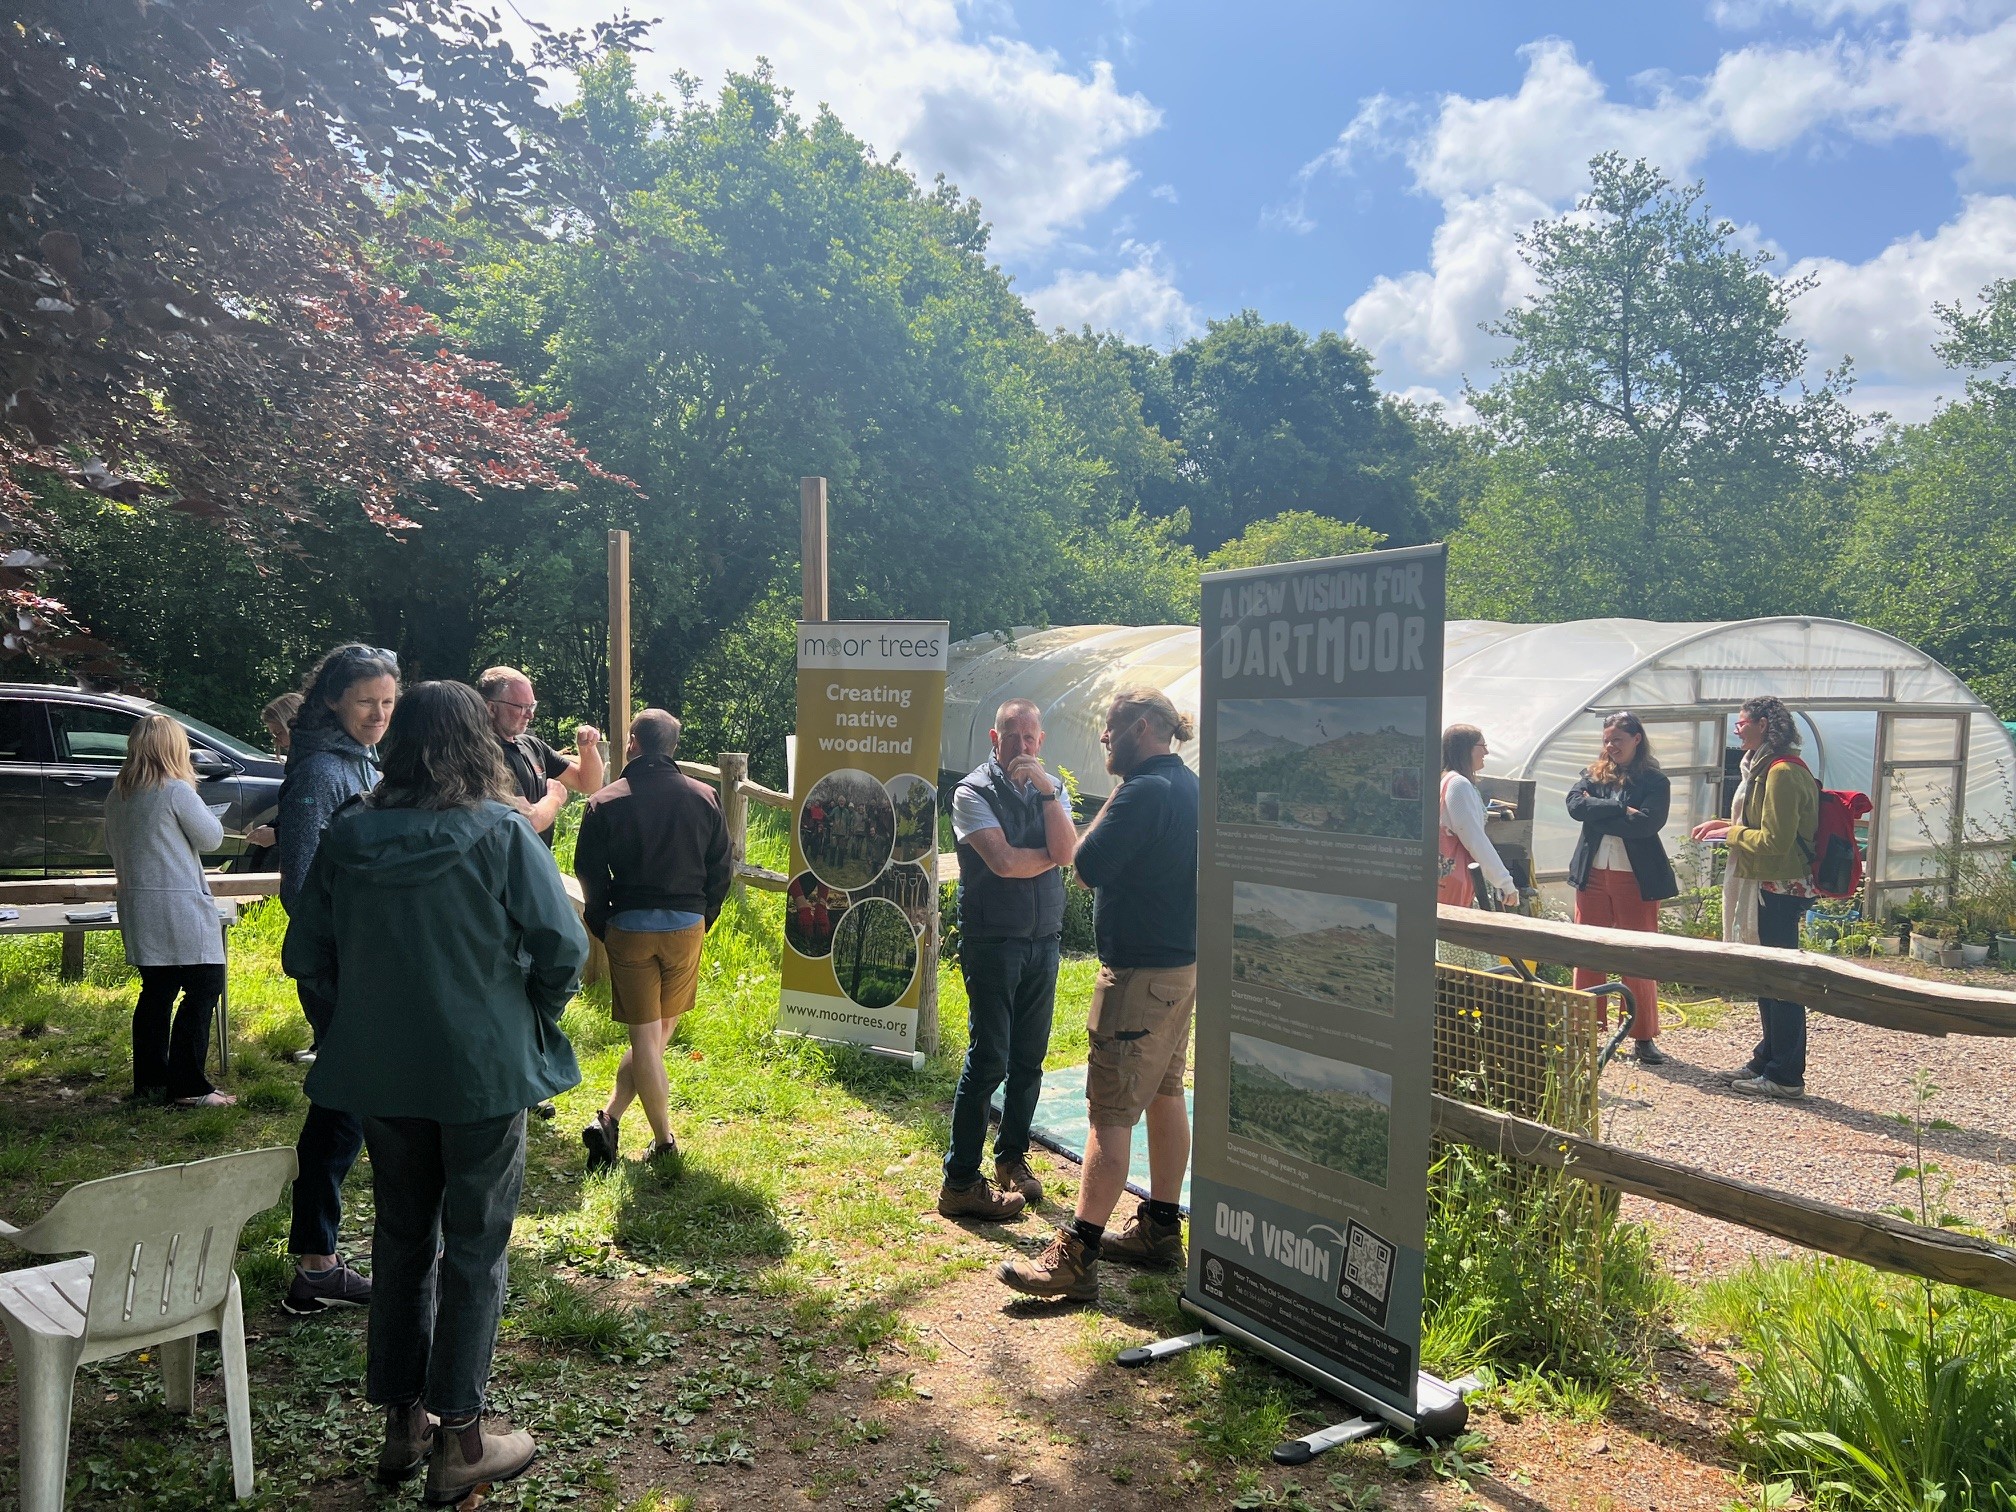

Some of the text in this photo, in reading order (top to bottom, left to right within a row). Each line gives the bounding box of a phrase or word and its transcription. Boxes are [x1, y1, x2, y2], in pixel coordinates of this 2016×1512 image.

[1220, 562, 1426, 619] A NEW VISION FOR
[878, 634, 939, 657] trees
[1220, 611, 1426, 687] DARTMOOR
[826, 683, 912, 708] Creating
[836, 710, 898, 728] native
[818, 735, 913, 755] woodland
[1215, 828, 1242, 839] Towards
[1269, 834, 1300, 844] Dartmoor
[1305, 837, 1320, 846] how
[1334, 841, 1356, 849] moor
[1357, 842, 1376, 852] could
[1377, 844, 1393, 854] look
[1404, 846, 1423, 857] 2050
[1231, 989, 1282, 1010] Dartmoor Today
[786, 1003, 908, 1037] www.moortrees.org
[1227, 1141, 1259, 1159] Dartmoor
[1279, 1162, 1297, 1176] years
[1298, 1168, 1309, 1180] ago
[1215, 1202, 1330, 1282] OUR VISION
[1233, 1270, 1246, 1281] Moor
[1259, 1282, 1268, 1293] The
[1267, 1287, 1277, 1298] Old
[1276, 1292, 1293, 1305] School
[1342, 1322, 1358, 1335] South
[1372, 1337, 1388, 1350] TQ10
[1352, 1293, 1378, 1315] SCAN ME
